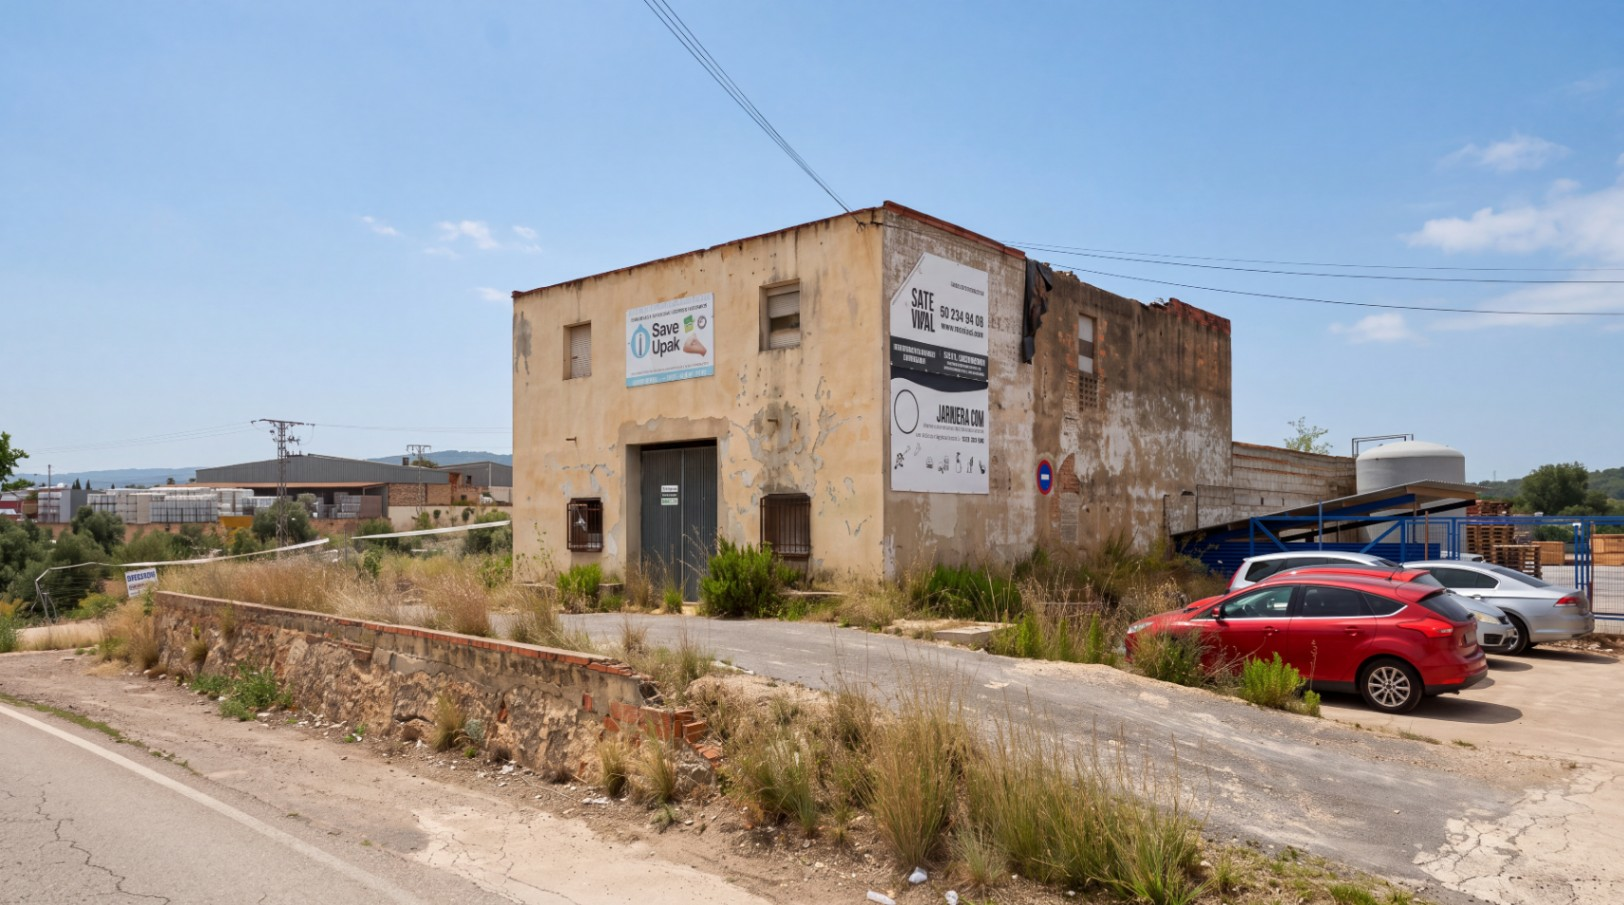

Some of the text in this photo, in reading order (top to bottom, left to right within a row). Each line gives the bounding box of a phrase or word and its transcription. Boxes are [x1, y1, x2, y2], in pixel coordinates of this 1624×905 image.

[911, 287, 934, 312] SATE
[950, 308, 964, 323] 234
[965, 311, 974, 325] 94
[652, 322, 680, 338] Save
[652, 336, 680, 357] Upak
